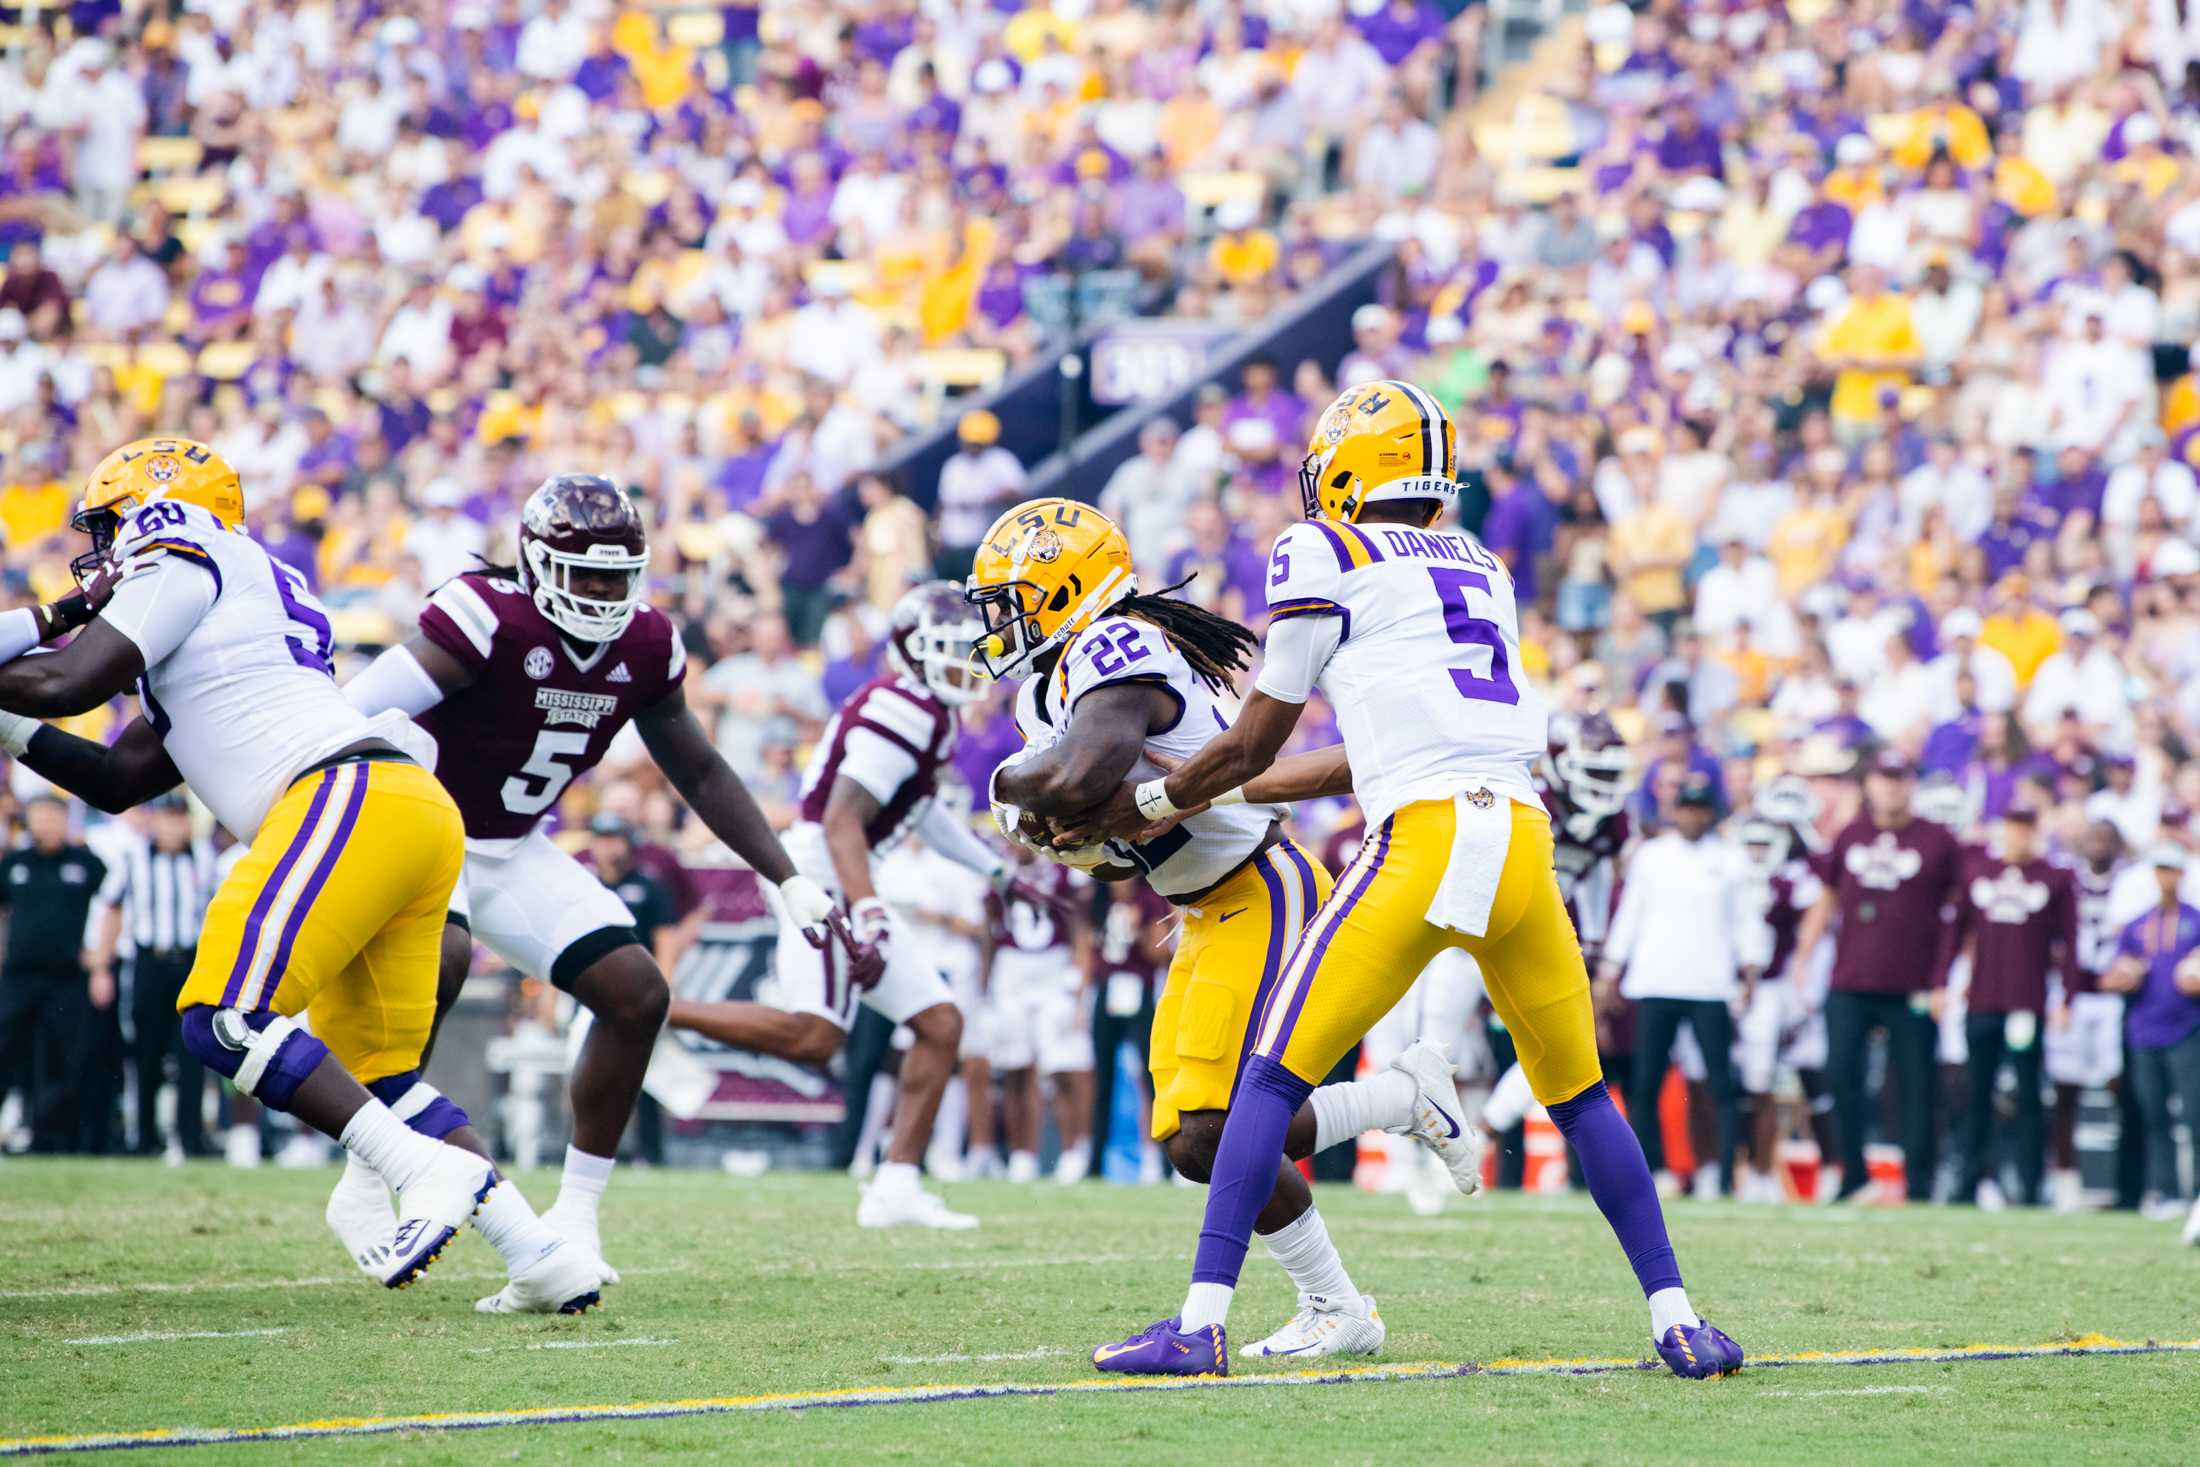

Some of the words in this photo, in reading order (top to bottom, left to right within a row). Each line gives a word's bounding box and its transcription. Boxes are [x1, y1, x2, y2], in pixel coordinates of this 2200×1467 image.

[121, 440, 211, 464] LSU
[1402, 481, 1457, 494] TIGERS
[992, 506, 1080, 558] LSU
[1271, 536, 1293, 587] 5
[1382, 530, 1498, 572] DANIELS
[1053, 617, 1075, 640] schutt
[1427, 566, 1520, 706] 5
[1081, 622, 1152, 677] 22
[536, 691, 617, 713] MISSISSIPPI
[550, 709, 595, 728] STATE
[500, 729, 591, 816] 5
[1309, 1294, 1327, 1304] LSU
